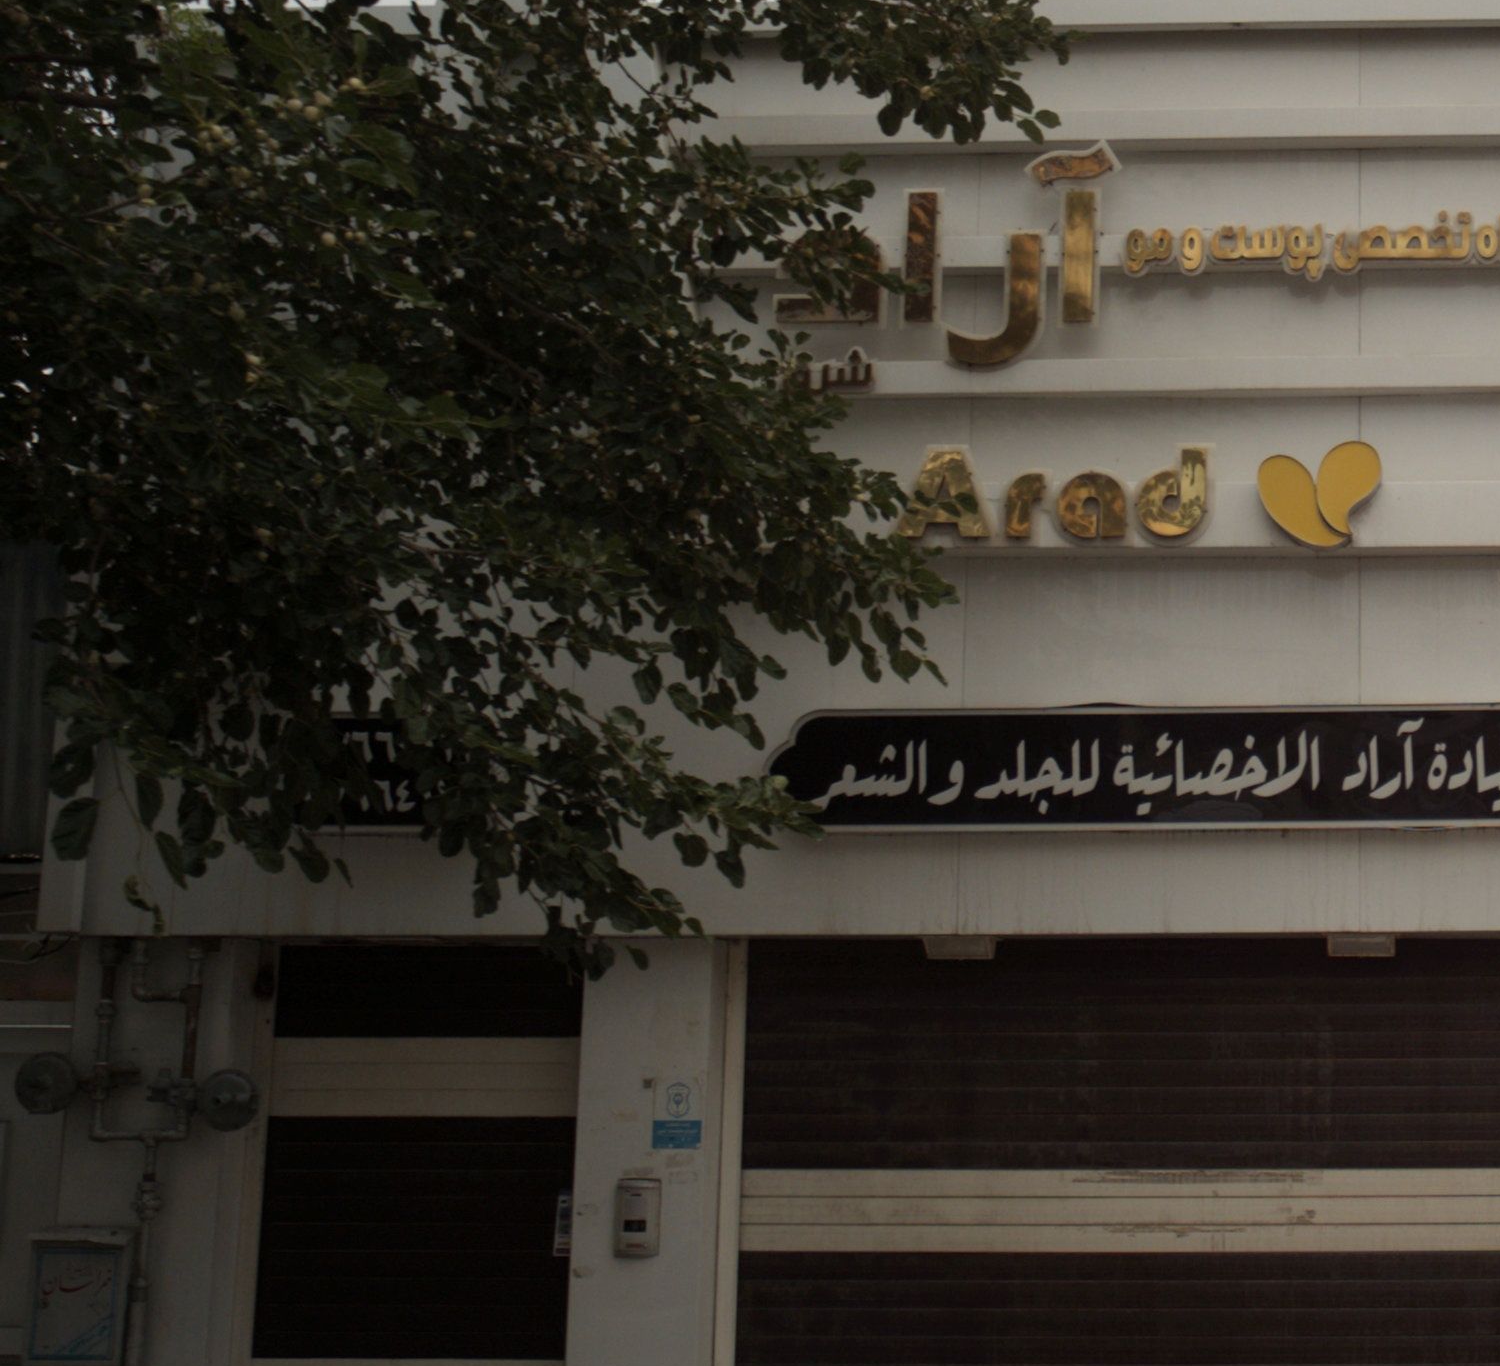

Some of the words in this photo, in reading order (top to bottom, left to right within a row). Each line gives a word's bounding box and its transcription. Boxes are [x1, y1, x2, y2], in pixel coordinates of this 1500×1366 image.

[1126, 228, 1174, 273] مو
[1181, 227, 1204, 272] و
[1209, 223, 1323, 280] پوست
[1332, 210, 1471, 271] تخصصی
[897, 447, 1208, 540] Arad
[811, 739, 928, 811] الشعر
[926, 759, 965, 806] و
[972, 739, 1100, 816] للجلد
[1342, 718, 1425, 800] آراد
